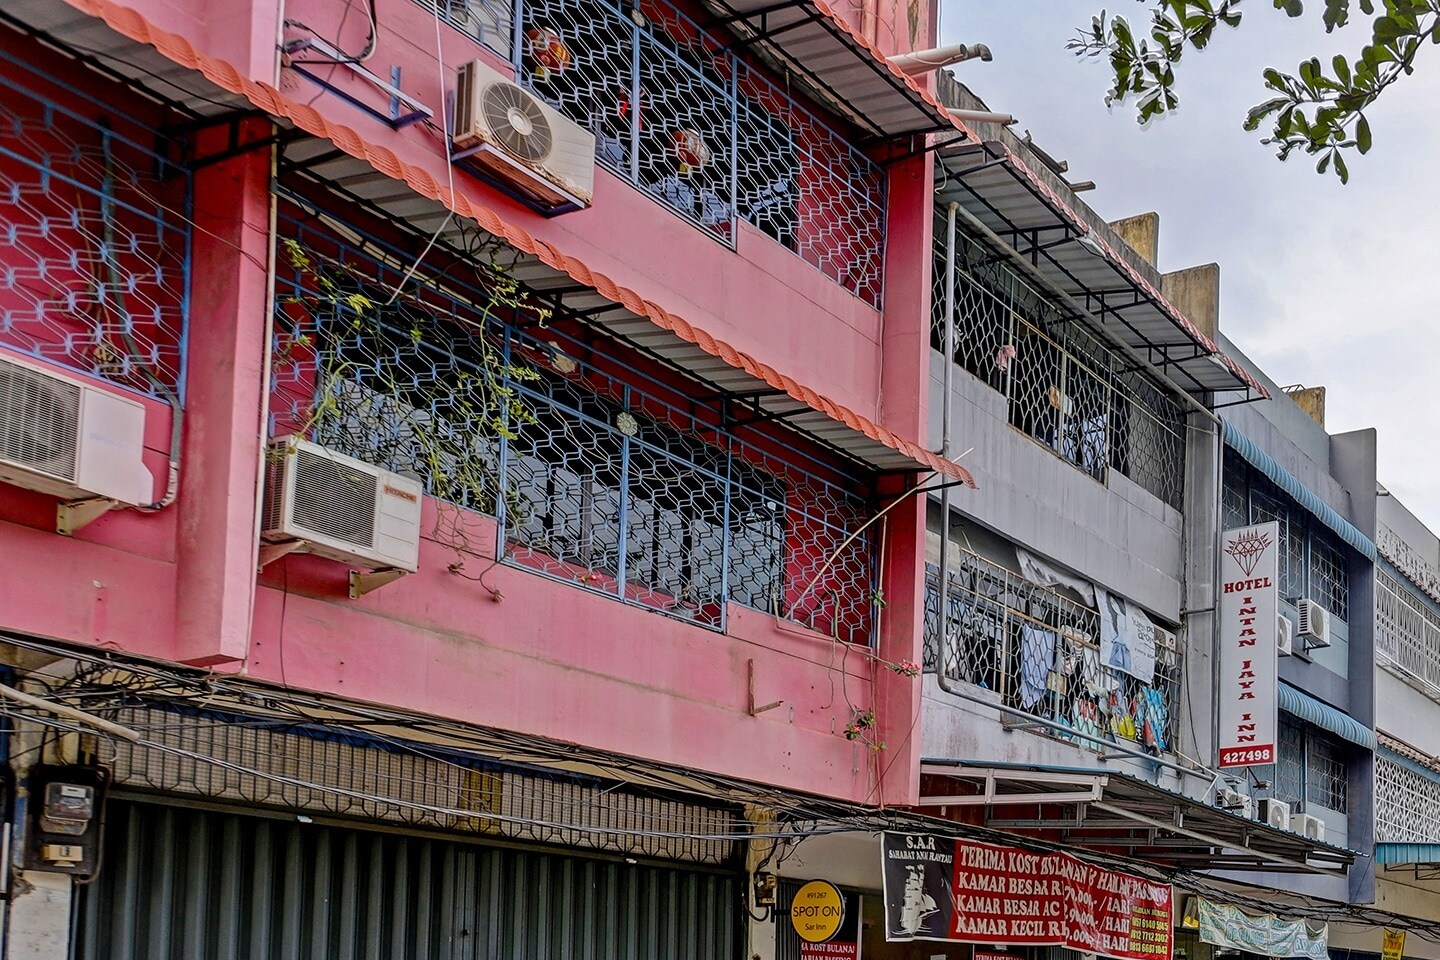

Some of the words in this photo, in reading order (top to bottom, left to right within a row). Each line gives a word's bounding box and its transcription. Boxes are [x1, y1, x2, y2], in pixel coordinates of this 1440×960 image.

[1223, 577, 1272, 594] HOTEL
[1238, 596, 1257, 648] INTAN
[1238, 660, 1256, 700] JAYA
[1237, 713, 1256, 743] INN
[1223, 749, 1270, 764] 427498
[960, 845, 1005, 873] TERIMA
[1009, 851, 1040, 875] KOST
[958, 871, 1005, 894] KAMAR
[1009, 878, 1048, 897] BESAR
[793, 906, 820, 917] SPOT
[822, 906, 840, 917] ON
[956, 895, 1001, 915] KAMAR
[1004, 899, 1040, 917] BESAR
[1043, 901, 1060, 917] AC
[805, 923, 816, 931] Sar
[955, 916, 1007, 936] KAMAR
[1011, 920, 1046, 936] KECIL
[810, 943, 827, 952] KOST
